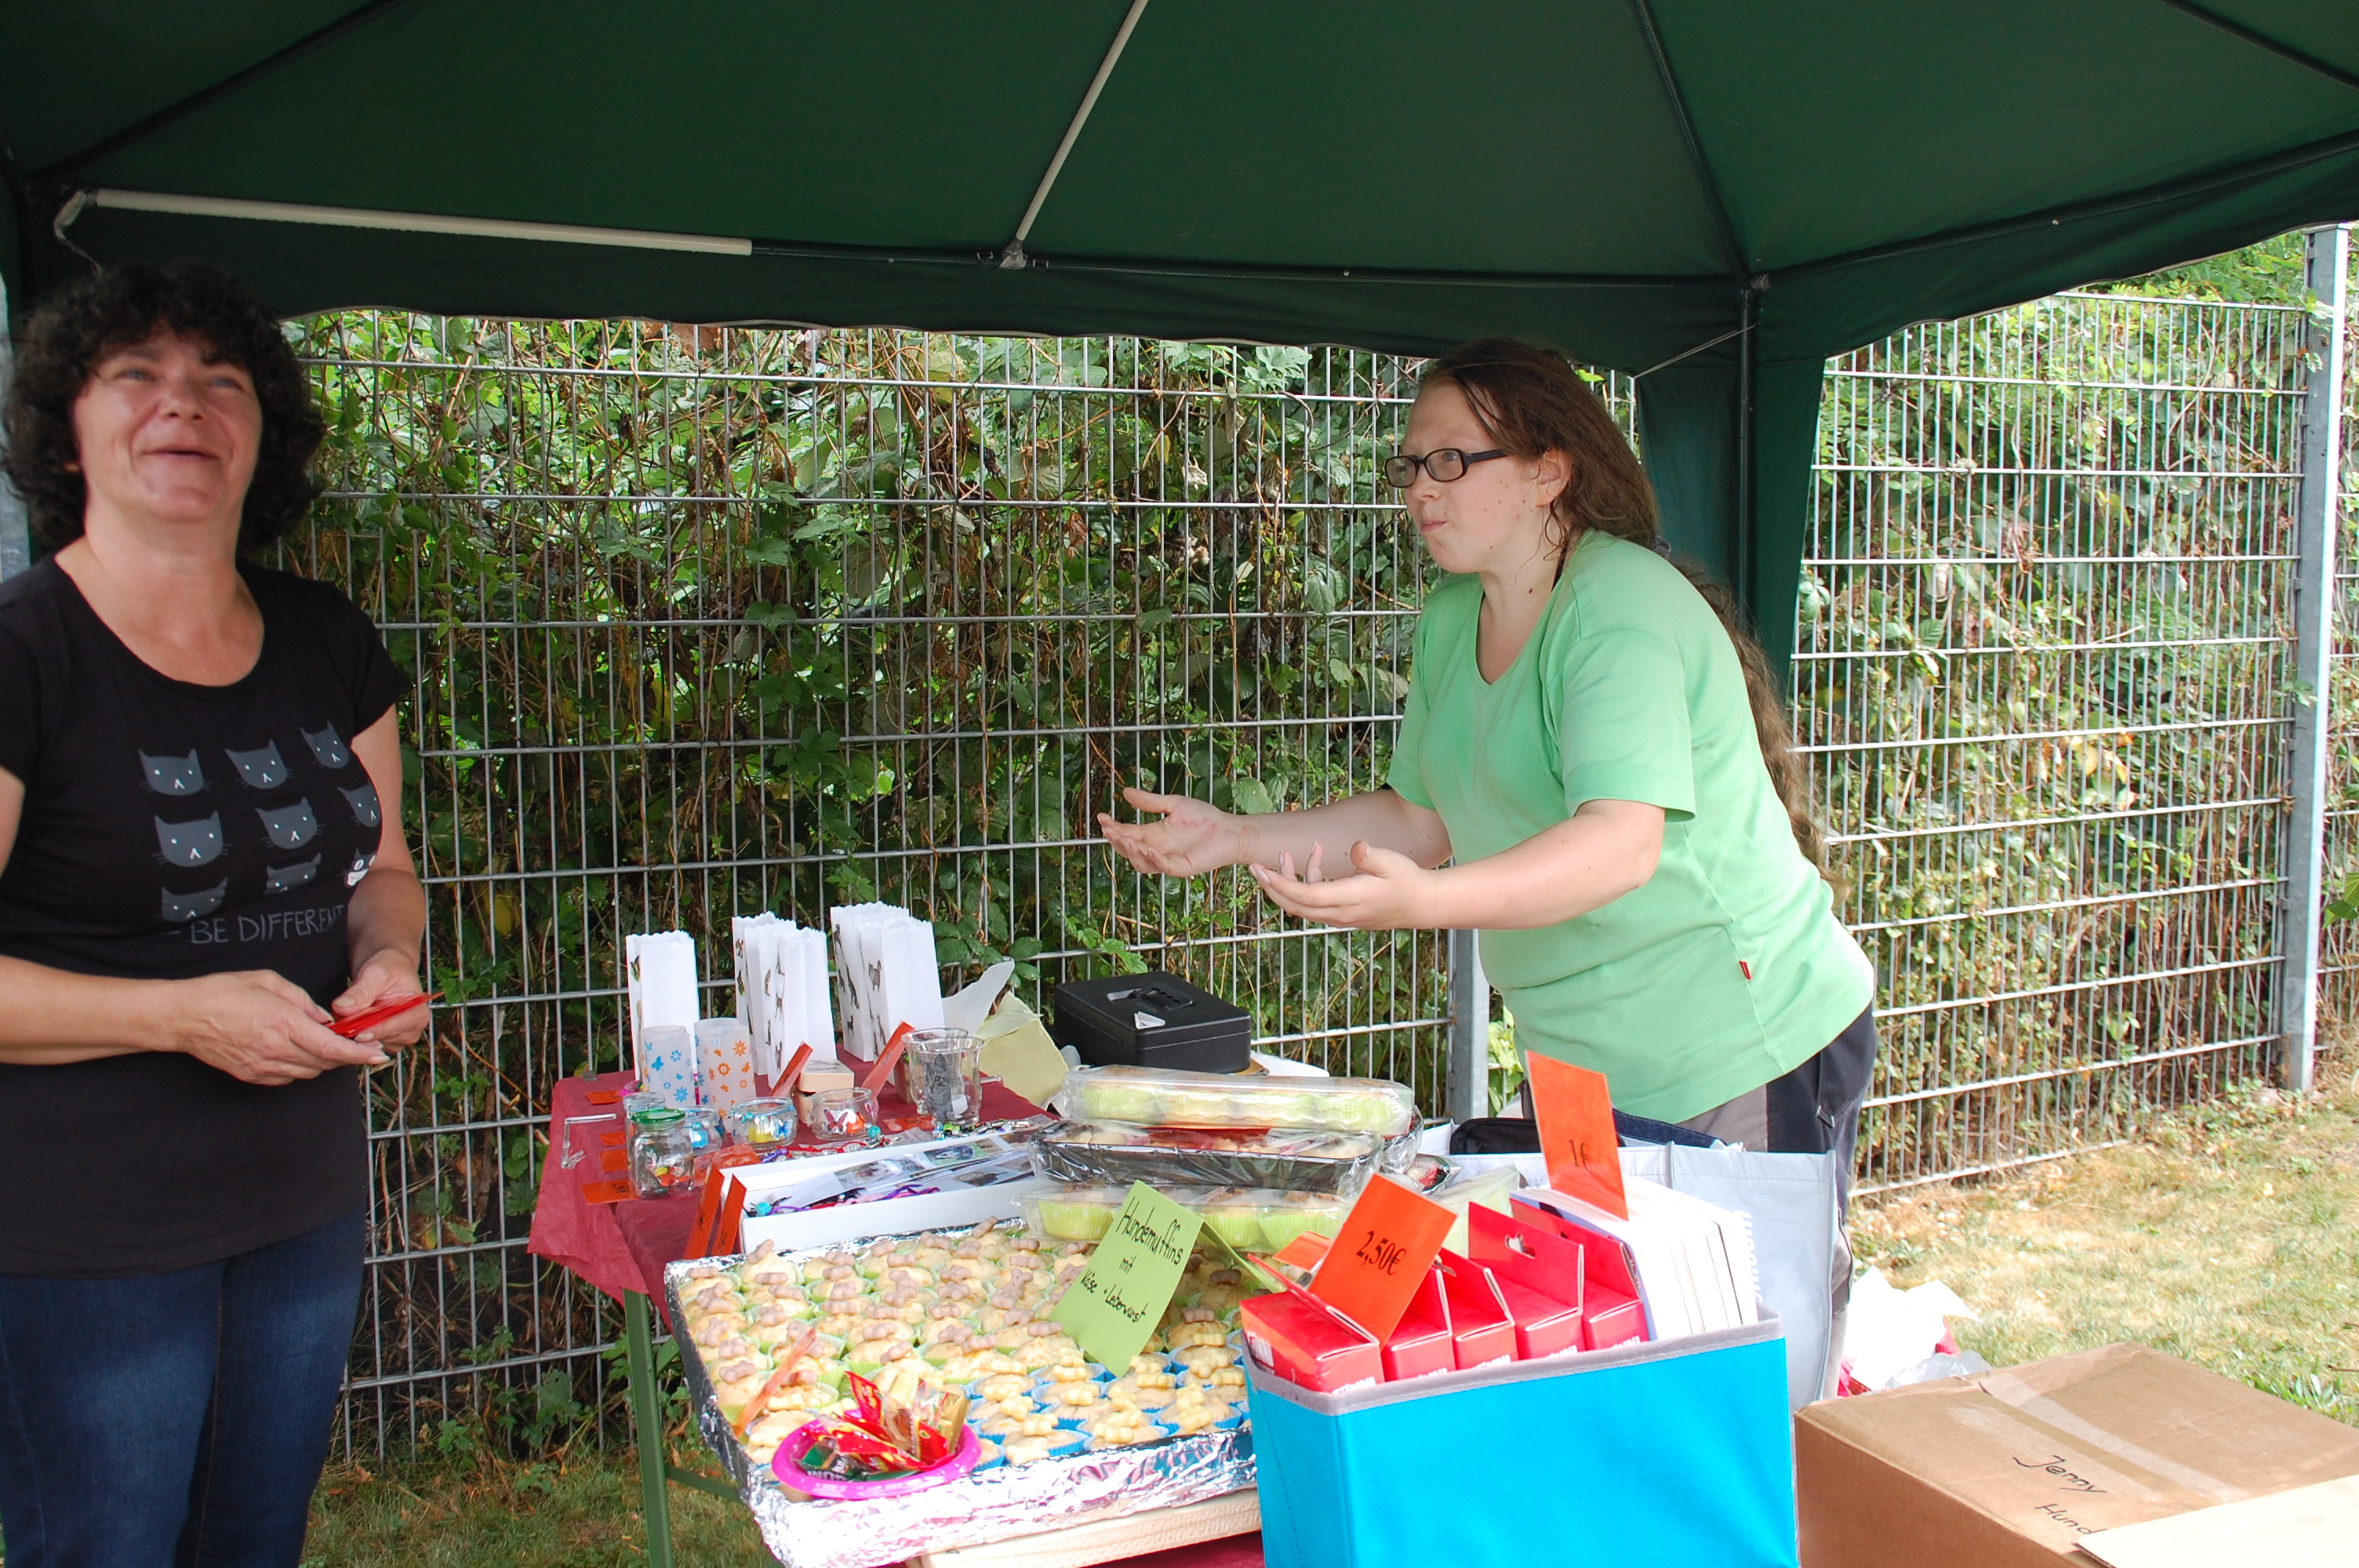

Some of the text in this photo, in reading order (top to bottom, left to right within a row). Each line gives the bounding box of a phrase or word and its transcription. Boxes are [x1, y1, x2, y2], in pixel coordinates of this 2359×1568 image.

[191, 905, 344, 944] BE DIFFERENT
[1568, 1139, 1592, 1173] 1€
[1115, 1196, 1183, 1265] Hundemuffins
[1119, 1254, 1136, 1274] mit
[1356, 1230, 1406, 1276] 2,50€
[2012, 1454, 2108, 1494] Jenny
[2034, 1502, 2109, 1535] Hund
